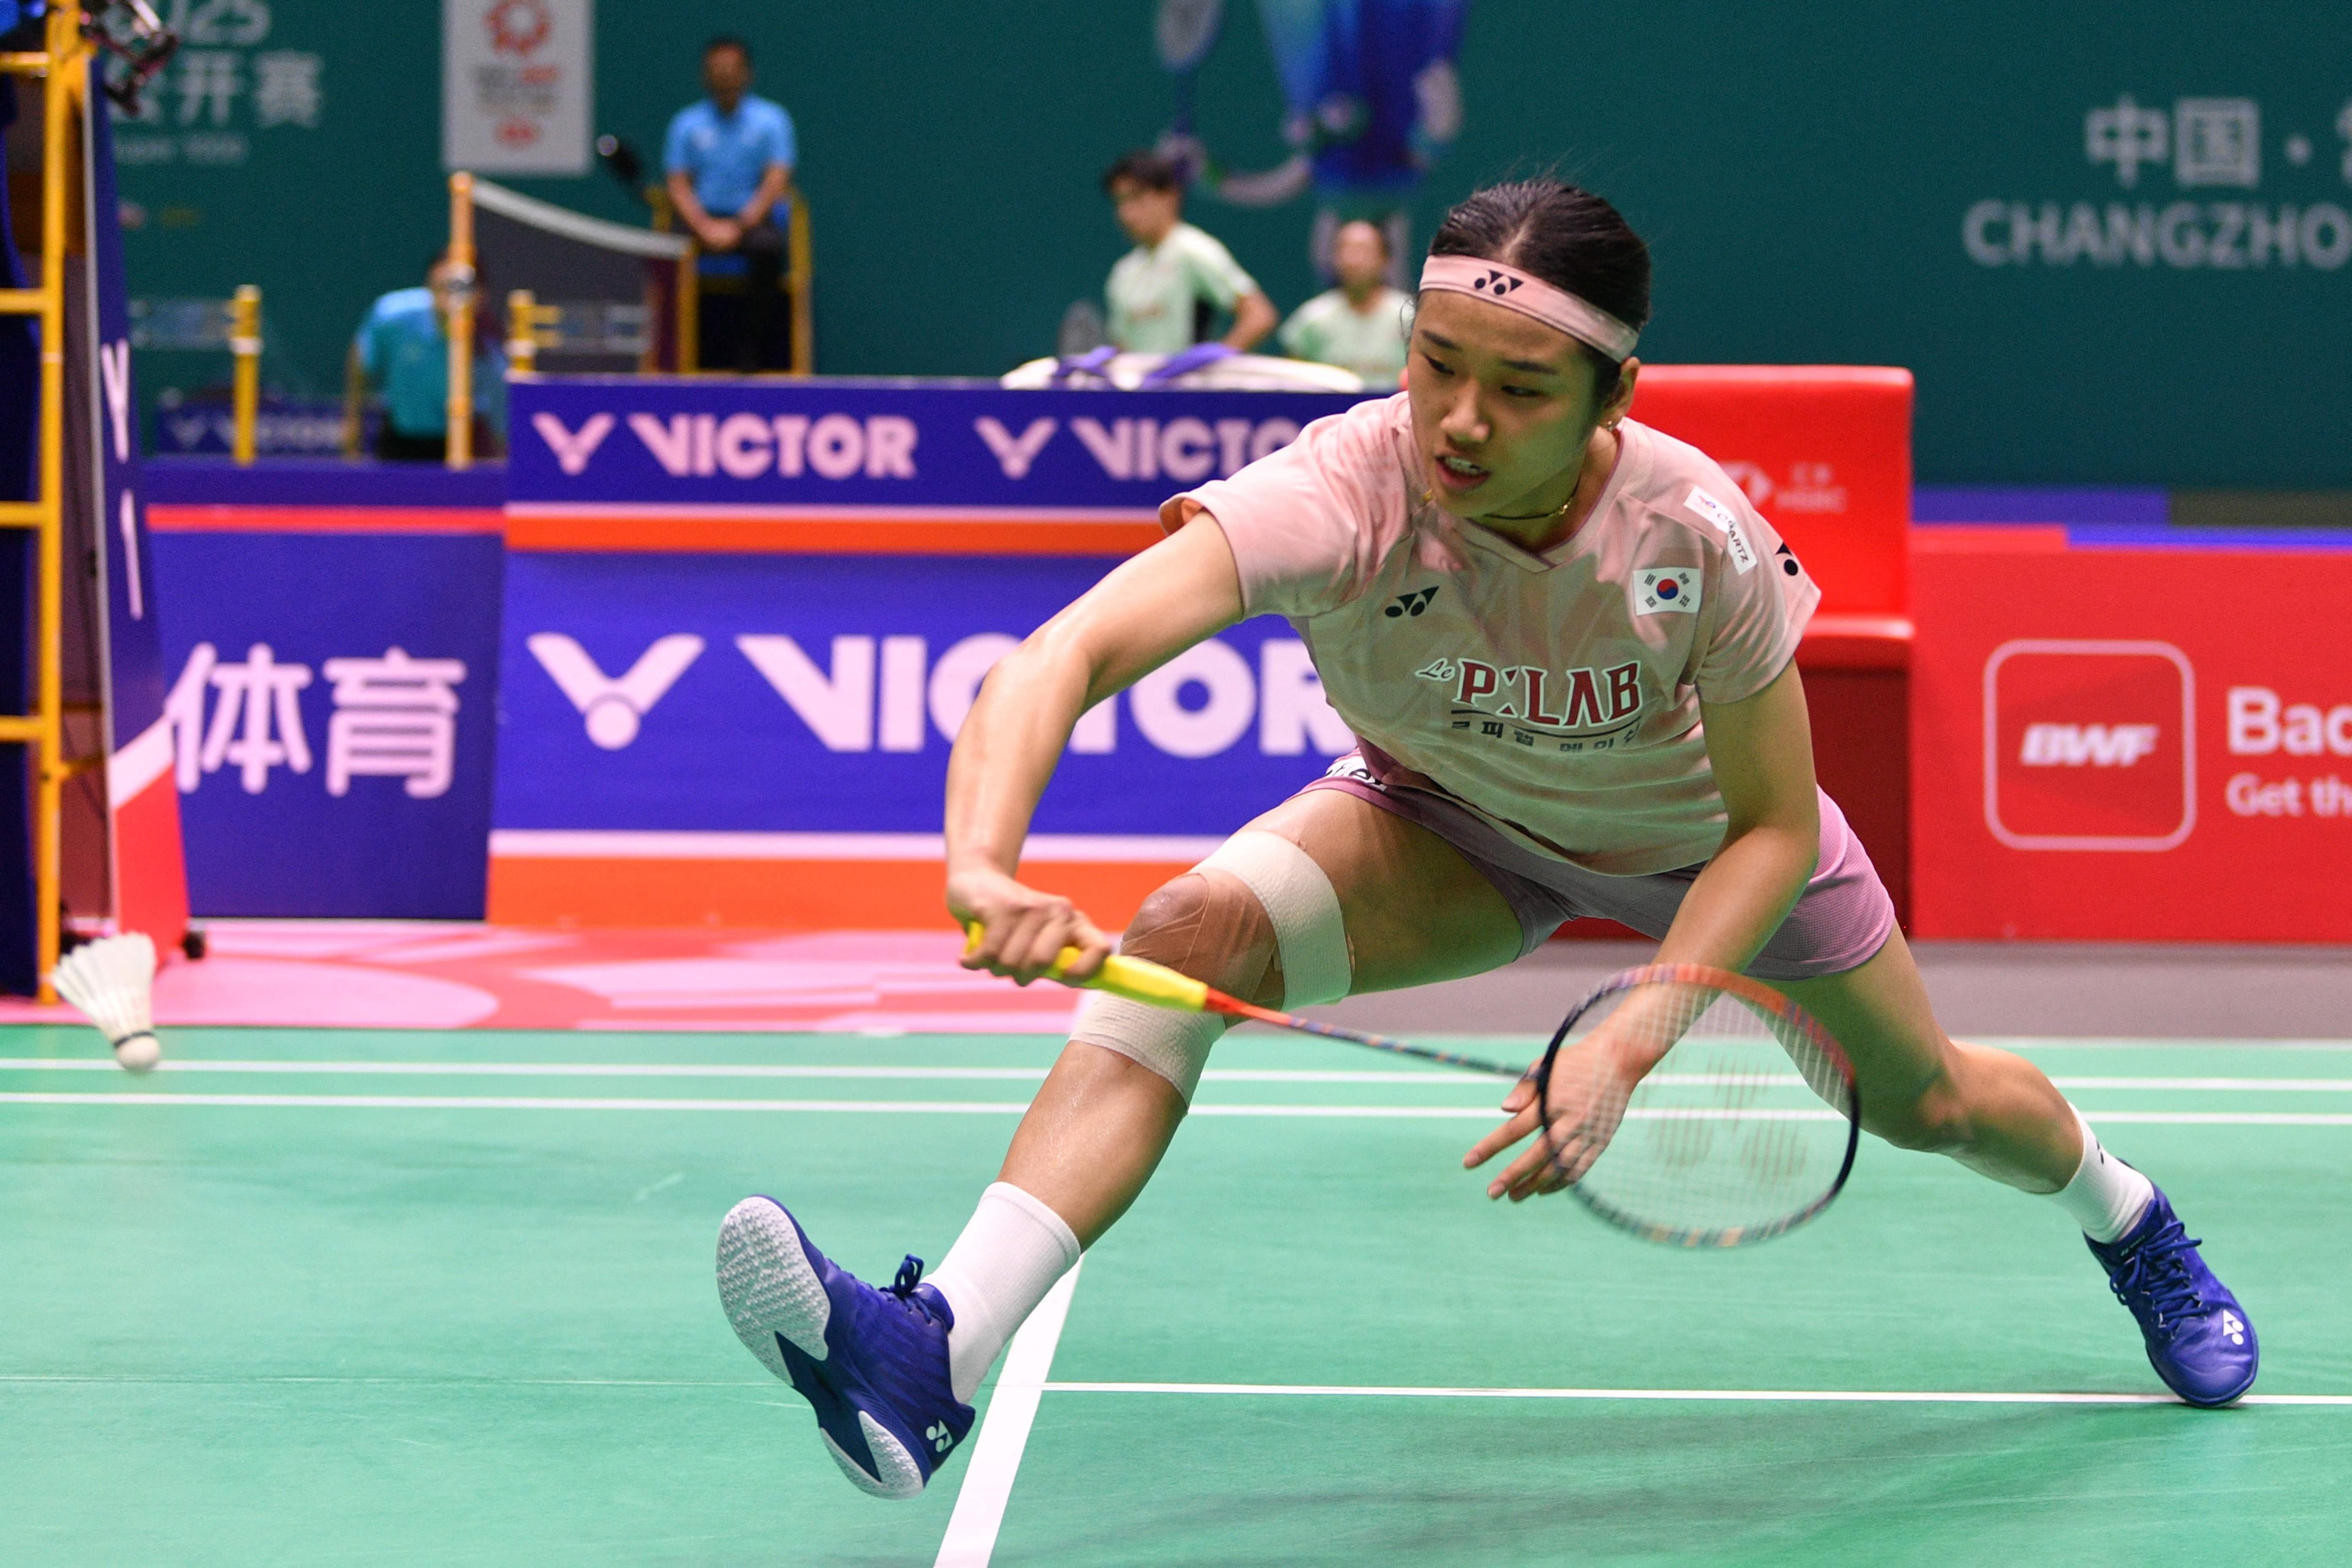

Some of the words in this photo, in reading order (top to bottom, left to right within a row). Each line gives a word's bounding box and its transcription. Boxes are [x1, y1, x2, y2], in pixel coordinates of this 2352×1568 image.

[628, 412, 918, 479] VICTOR
[735, 633, 1359, 758] VICOR
[1415, 658, 1455, 681] Le
[163, 641, 467, 798] 体育
[2021, 724, 2159, 767] BWF
[2225, 772, 2304, 817] Get
